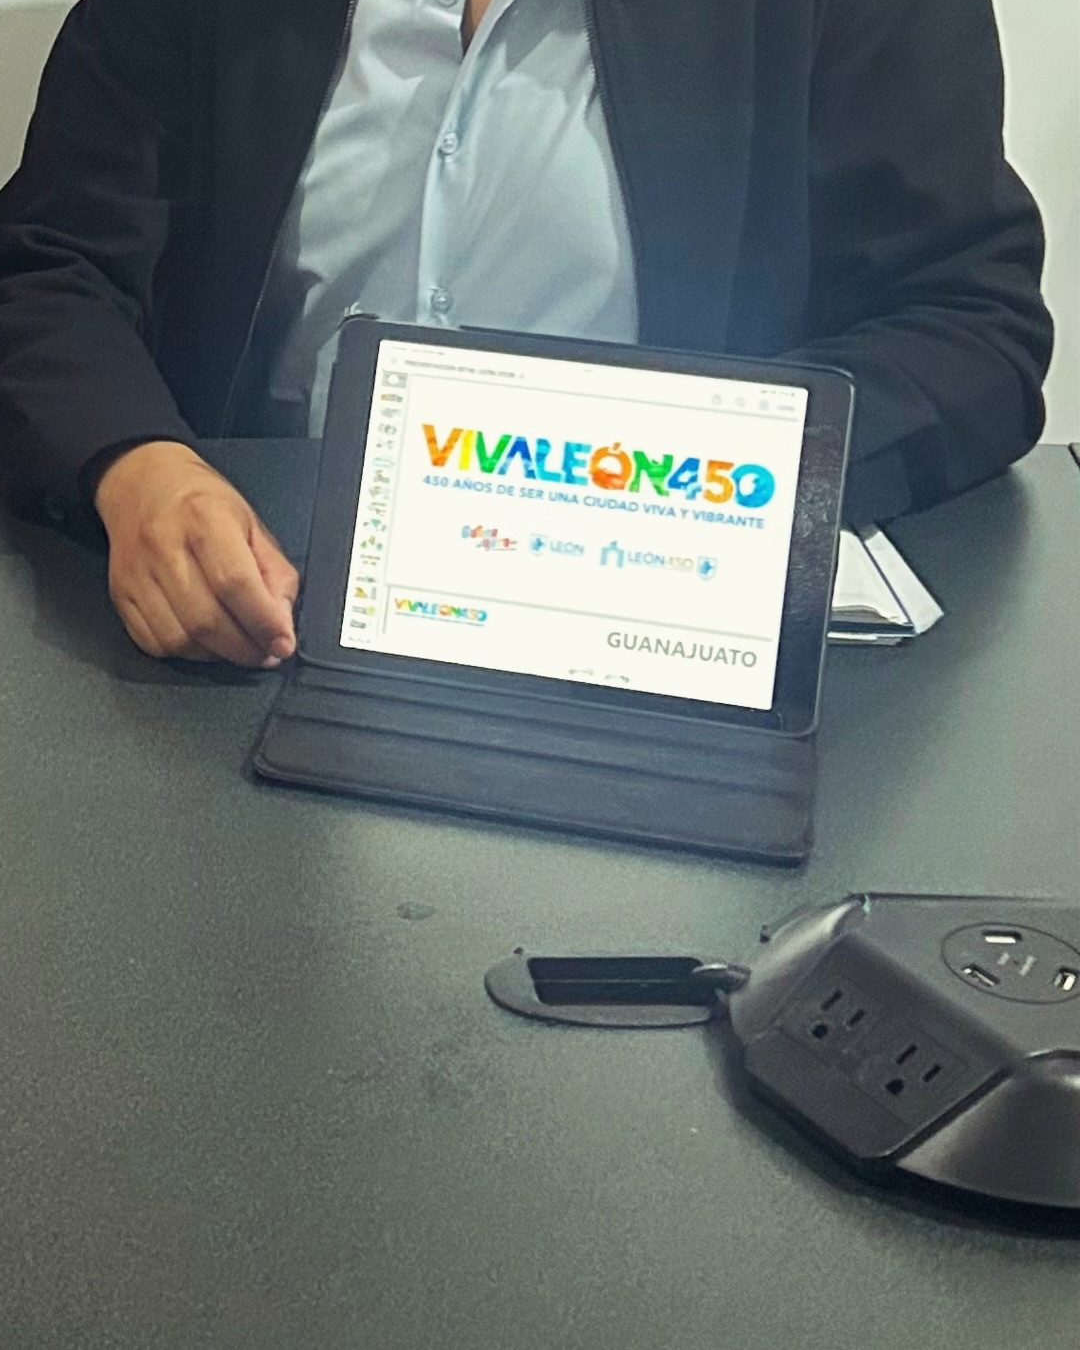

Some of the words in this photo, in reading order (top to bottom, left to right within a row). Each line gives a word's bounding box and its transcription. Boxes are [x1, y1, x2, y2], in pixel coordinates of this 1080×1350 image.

[422, 423, 776, 508] VIVALEÓN450
[423, 475, 448, 487] 450
[453, 478, 493, 494] AÑOS
[496, 484, 514, 496] DE
[520, 487, 544, 500] SER
[549, 492, 579, 505] UNA
[583, 495, 639, 512] CIUDAD
[643, 503, 676, 518] VIVA
[679, 508, 689, 520] Y
[692, 509, 765, 530] VIBRANTE
[606, 631, 758, 668] GUANAJUATO
